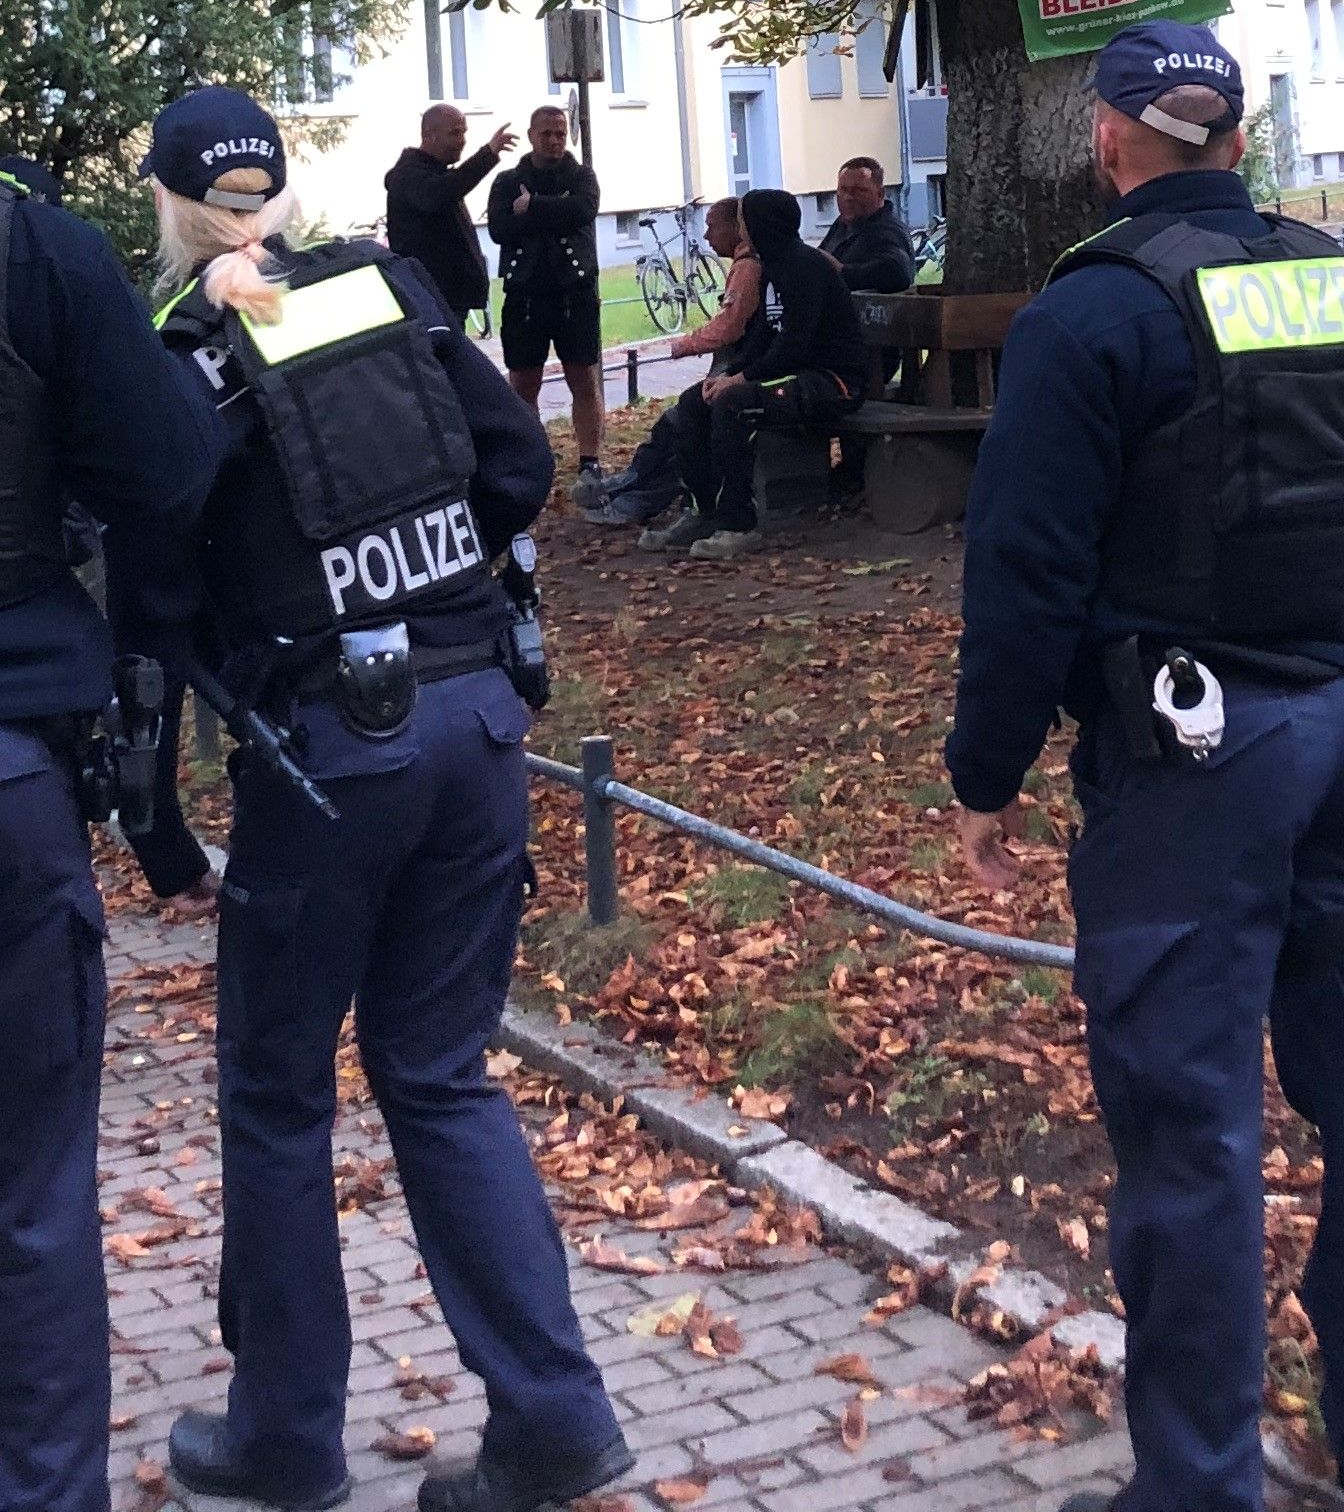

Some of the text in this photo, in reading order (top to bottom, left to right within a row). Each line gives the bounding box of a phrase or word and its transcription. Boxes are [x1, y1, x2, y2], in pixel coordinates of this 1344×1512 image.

[1153, 52, 1231, 78] POLIZEI
[199, 136, 277, 167] POLIZEI
[320, 498, 485, 616] POLIZEI
